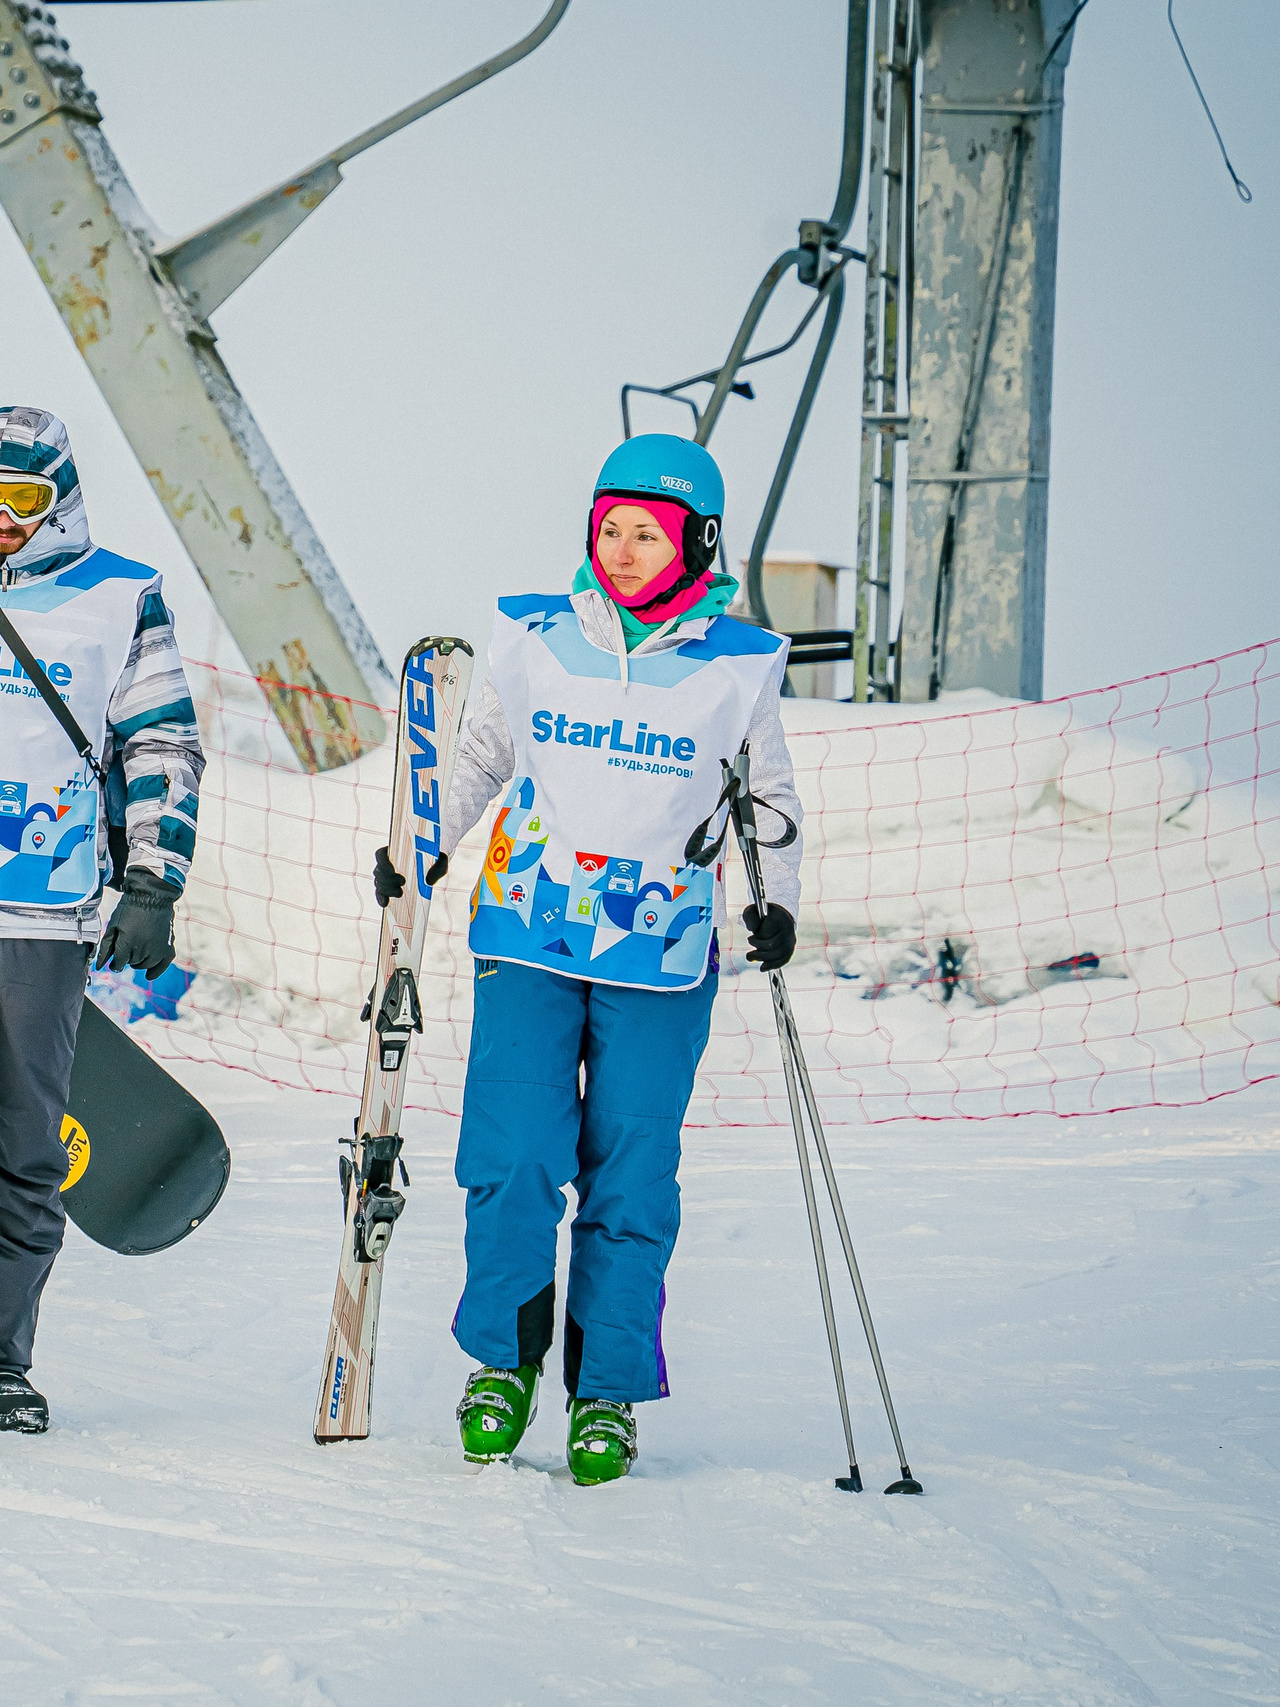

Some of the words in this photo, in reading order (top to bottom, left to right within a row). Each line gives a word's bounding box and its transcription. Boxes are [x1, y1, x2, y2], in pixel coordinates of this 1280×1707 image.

[660, 475, 694, 493] VIZZO
[531, 710, 696, 762] StarLine
[406, 648, 440, 901] CLEVER
[607, 757, 694, 780] #БУДЬЗДОРОВ!
[391, 937, 400, 957] 156
[67, 1137, 88, 1172] 160
[330, 1356, 345, 1420] CLEVER
